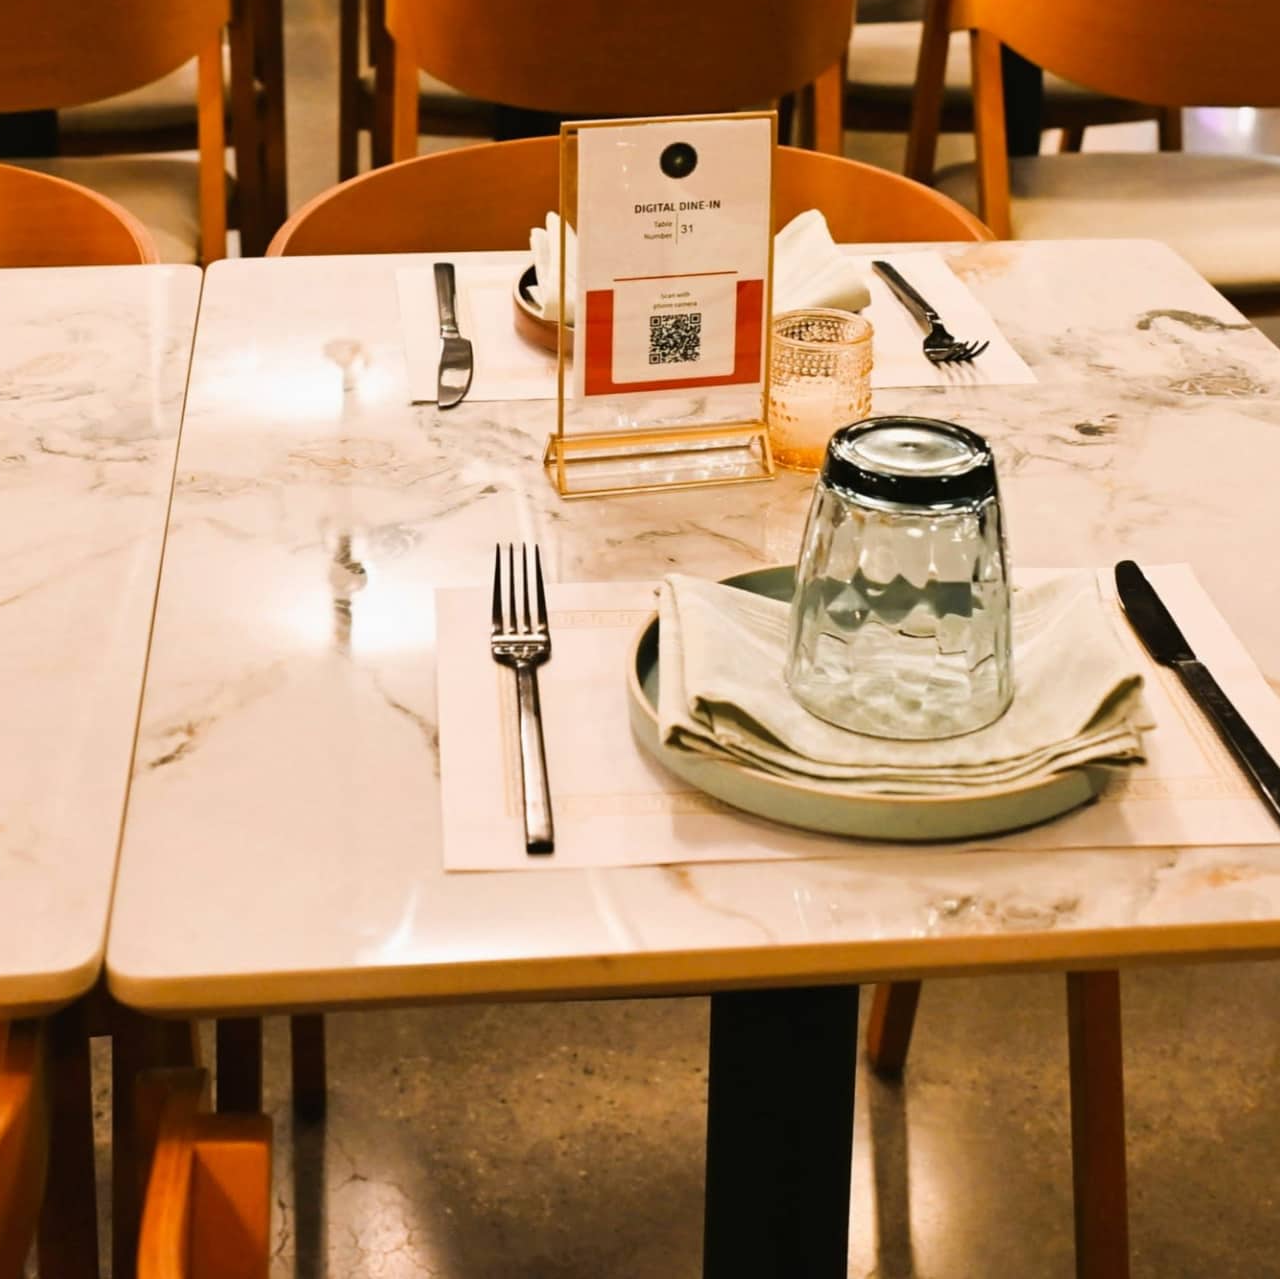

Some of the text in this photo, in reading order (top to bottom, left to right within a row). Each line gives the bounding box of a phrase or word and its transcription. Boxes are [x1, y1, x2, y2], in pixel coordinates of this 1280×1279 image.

[634, 200, 721, 214] DIGITAL DINE-IN
[680, 224, 694, 234] 31
